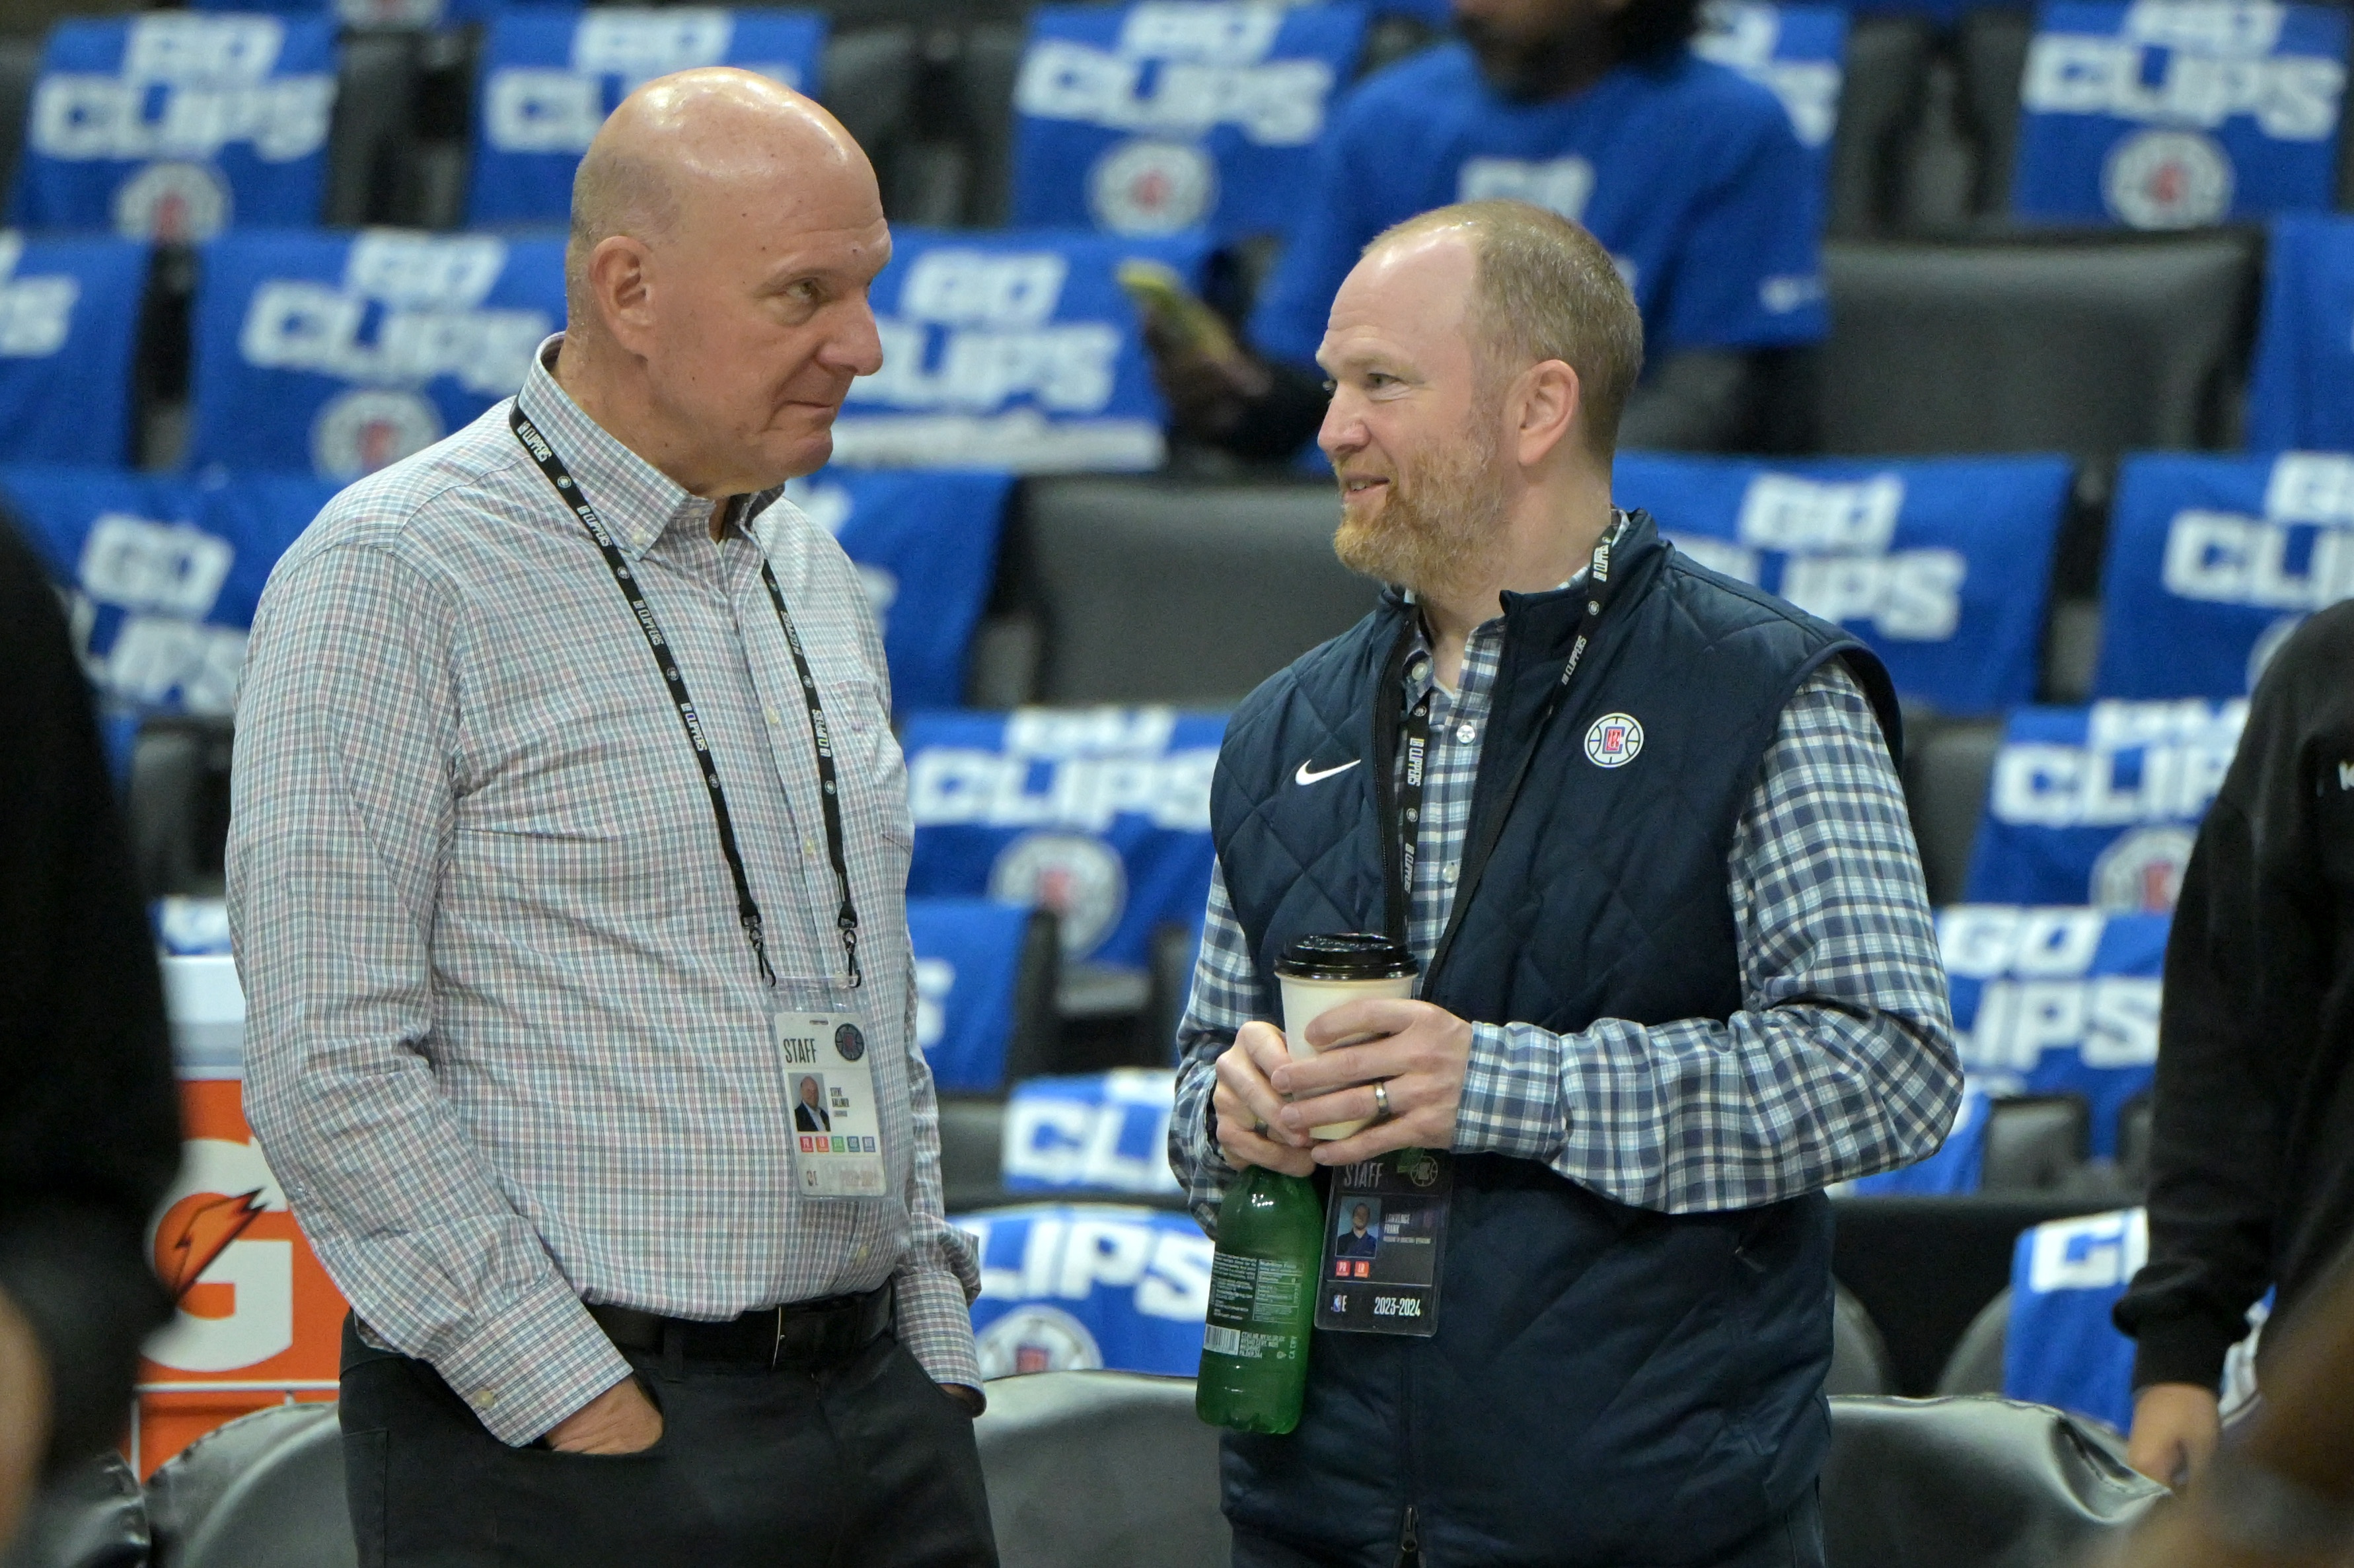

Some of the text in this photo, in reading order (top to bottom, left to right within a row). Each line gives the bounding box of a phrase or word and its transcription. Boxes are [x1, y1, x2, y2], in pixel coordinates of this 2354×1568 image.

[522, 429, 552, 462] CLIPPERS
[583, 513, 613, 548] CLIPPERS
[638, 608, 664, 647] CLIPPERS
[1565, 634, 1587, 676] CLIPPERS
[685, 713, 708, 752] CLIPPERS
[812, 709, 830, 748] CLIPPERS
[1407, 748, 1423, 787] CLIPPERS
[1404, 855, 1414, 894] CLIPPERS
[783, 1038, 817, 1064] STAFF
[1344, 1162, 1383, 1188] STAFF
[144, 1138, 293, 1372] G
[1374, 1296, 1421, 1317] 2023-2024
